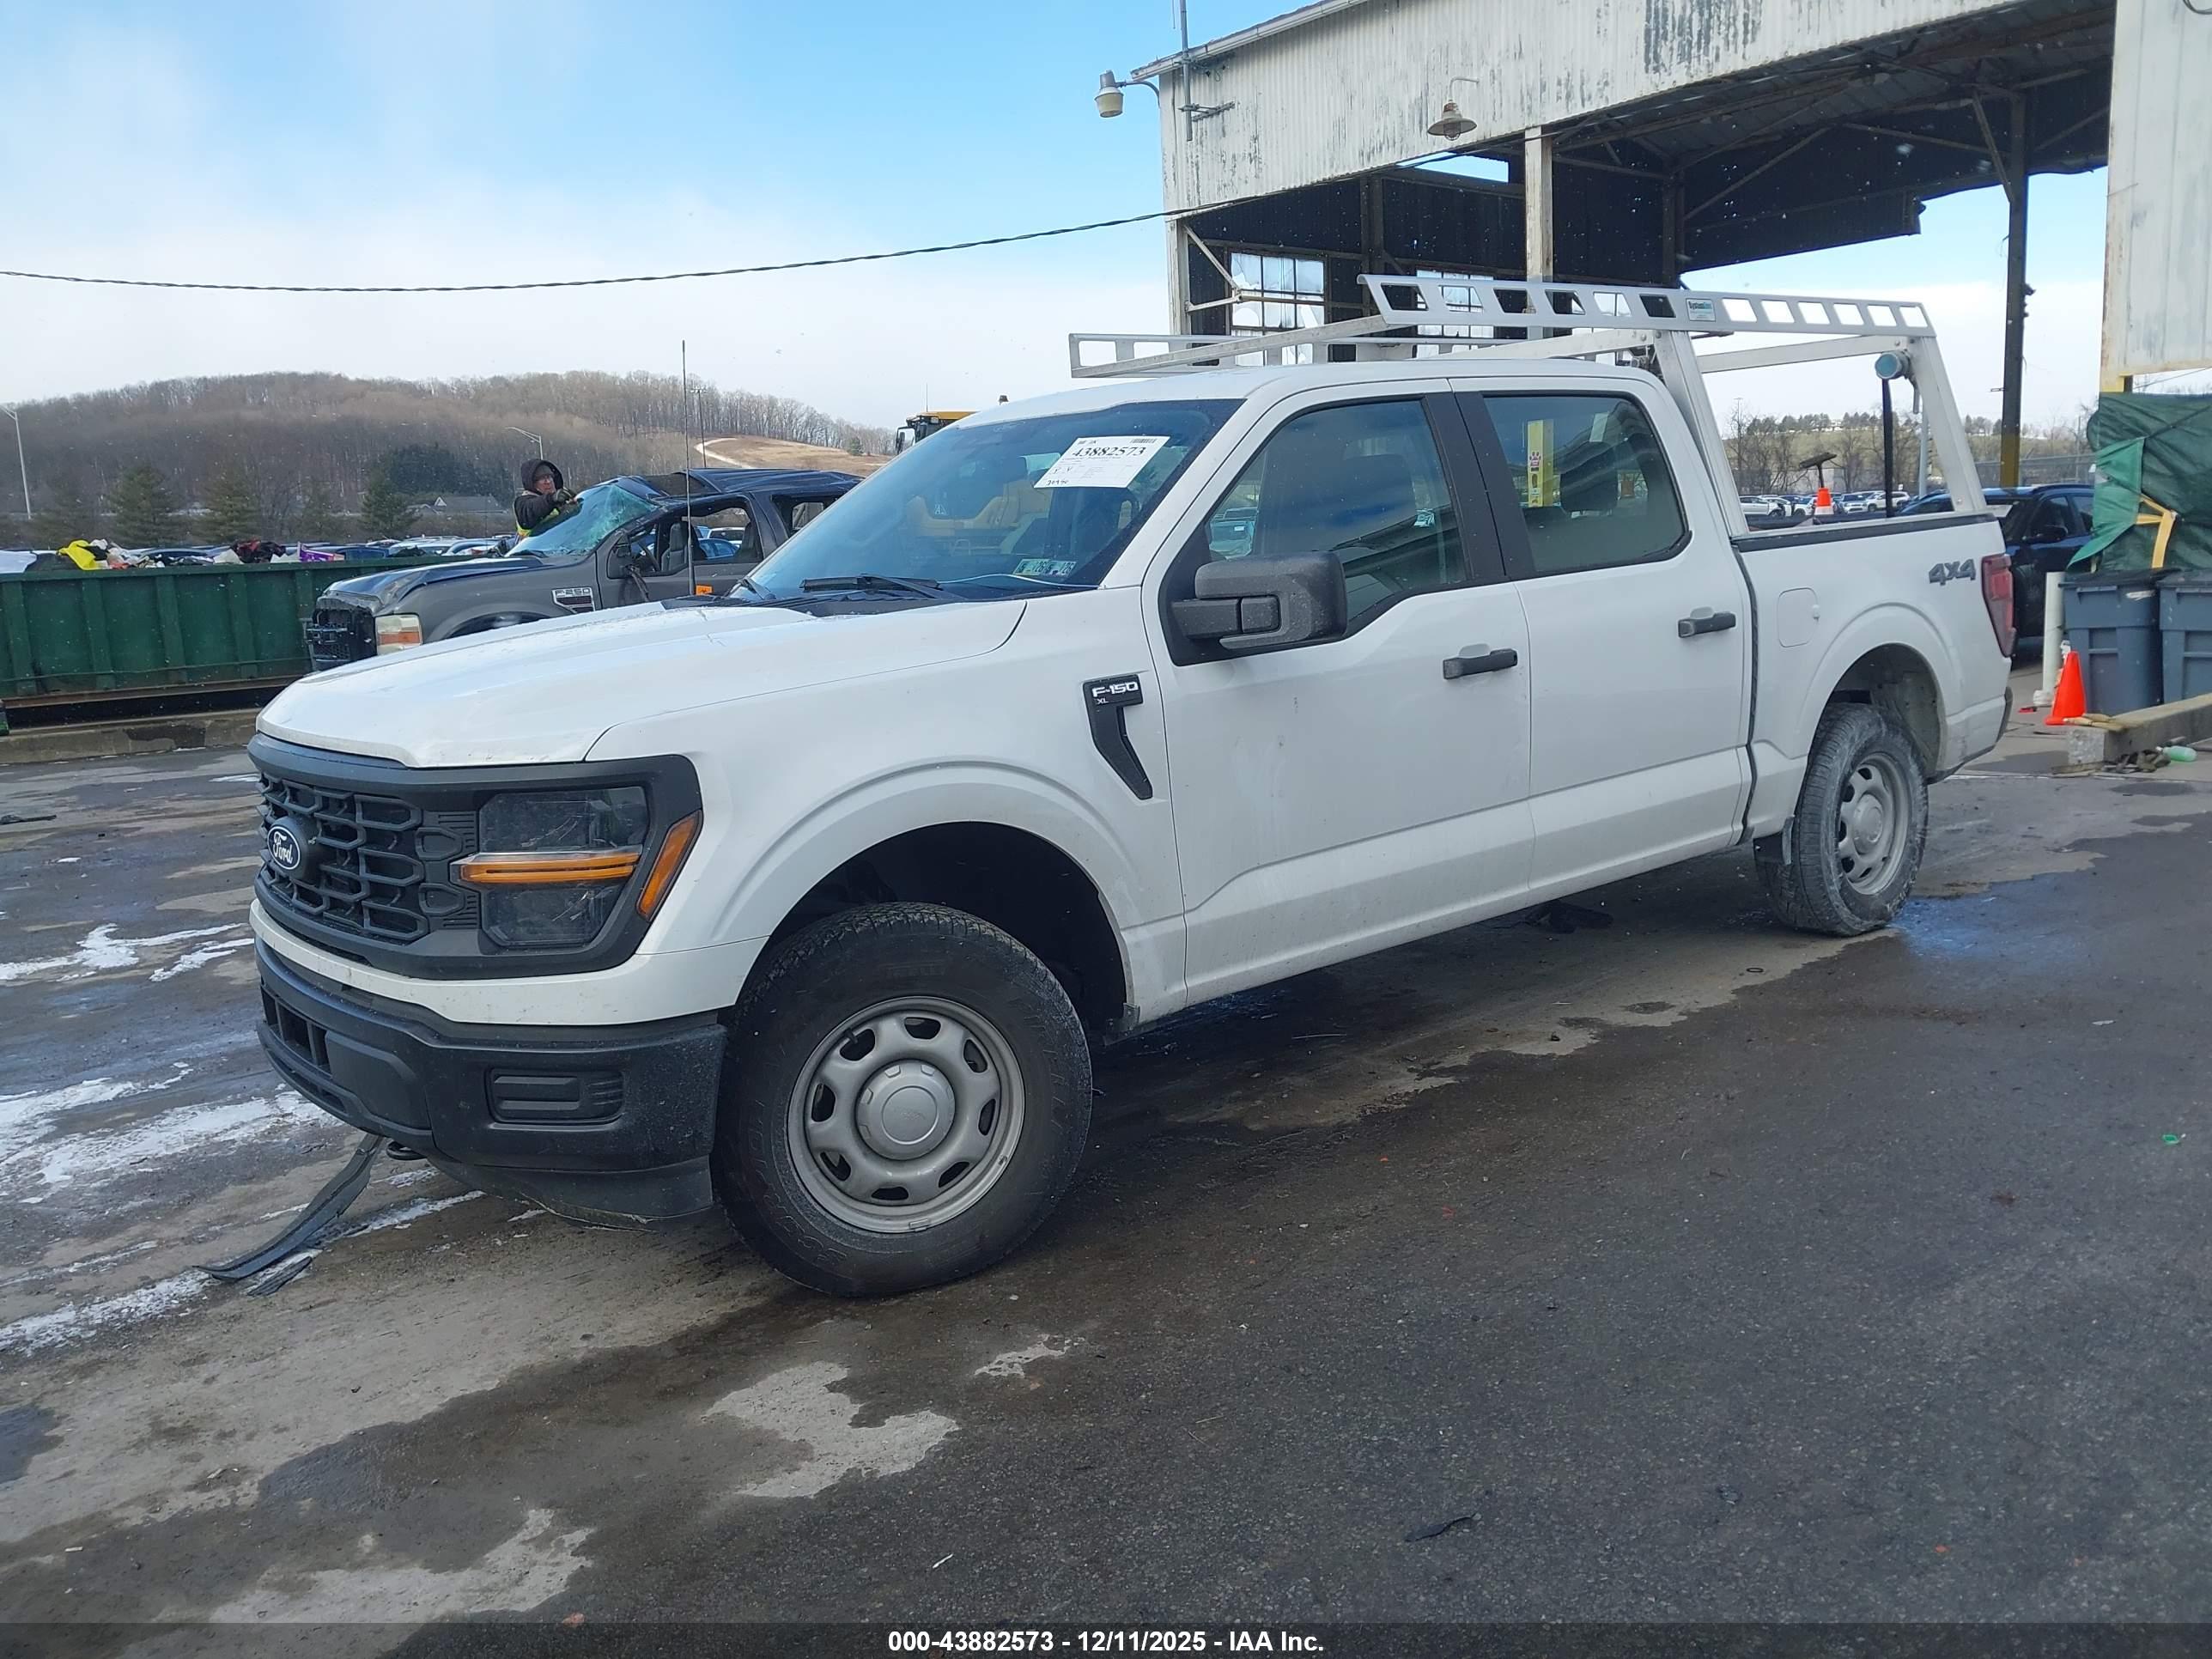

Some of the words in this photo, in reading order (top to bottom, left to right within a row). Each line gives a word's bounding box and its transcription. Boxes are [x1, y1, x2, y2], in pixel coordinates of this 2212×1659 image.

[1072, 446, 1148, 458] 43882573
[1091, 681, 1139, 697] F-150
[273, 830, 294, 865] Ford
